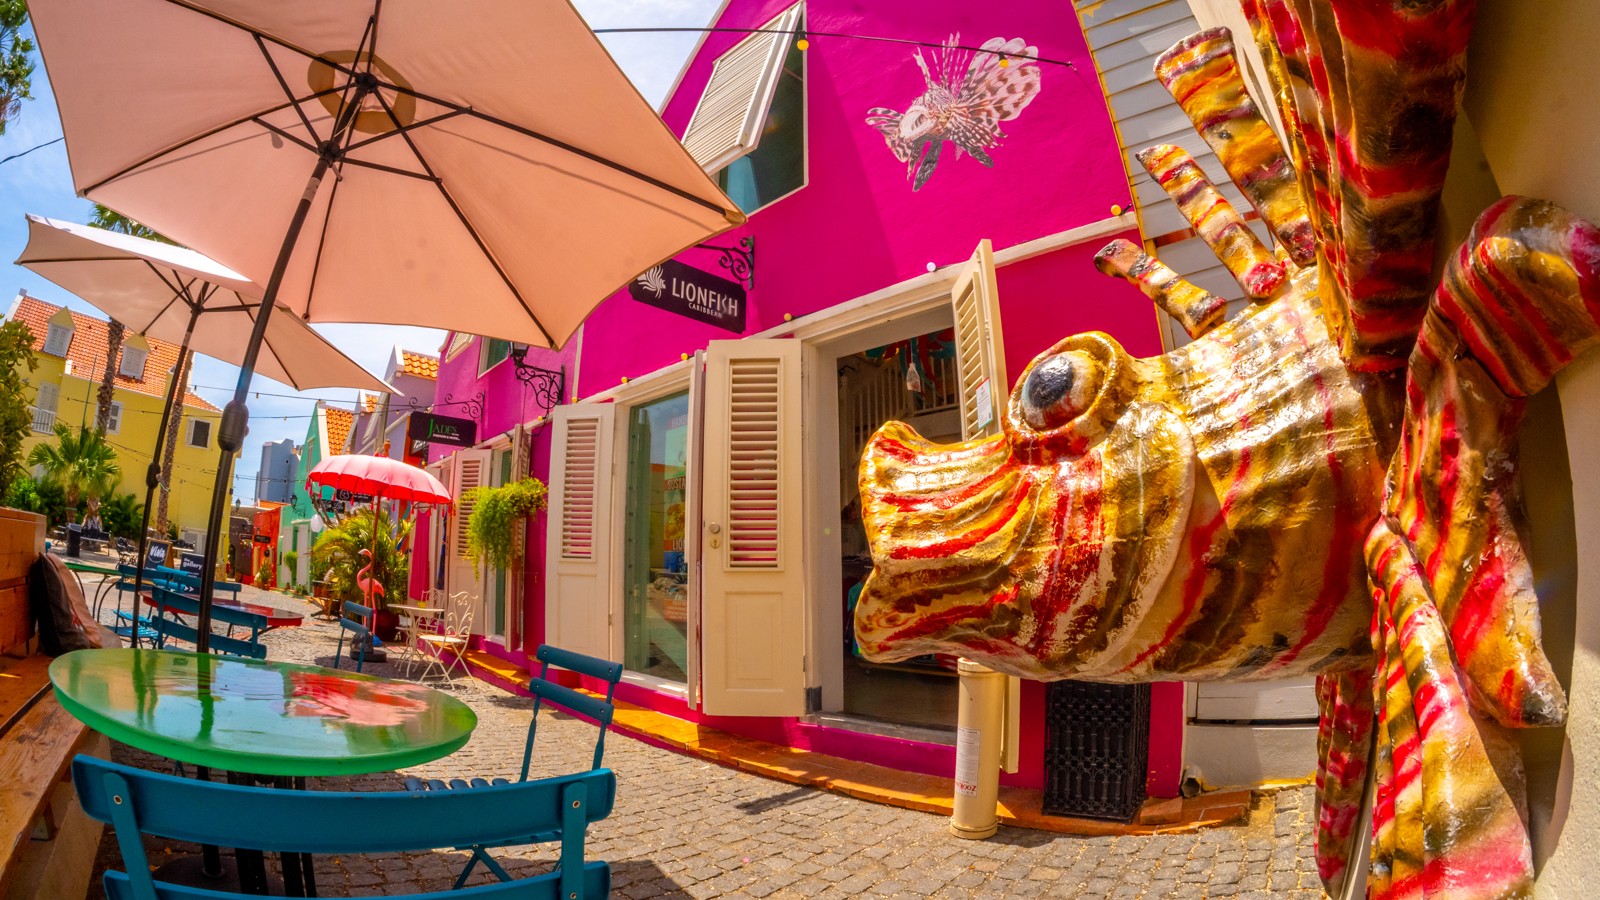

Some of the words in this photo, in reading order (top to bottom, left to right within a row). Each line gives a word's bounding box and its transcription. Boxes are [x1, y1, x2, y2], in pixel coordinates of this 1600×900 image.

[671, 277, 738, 317] LIONFISH
[688, 302, 723, 319] CARIBBEAN
[182, 560, 203, 570] gallery
